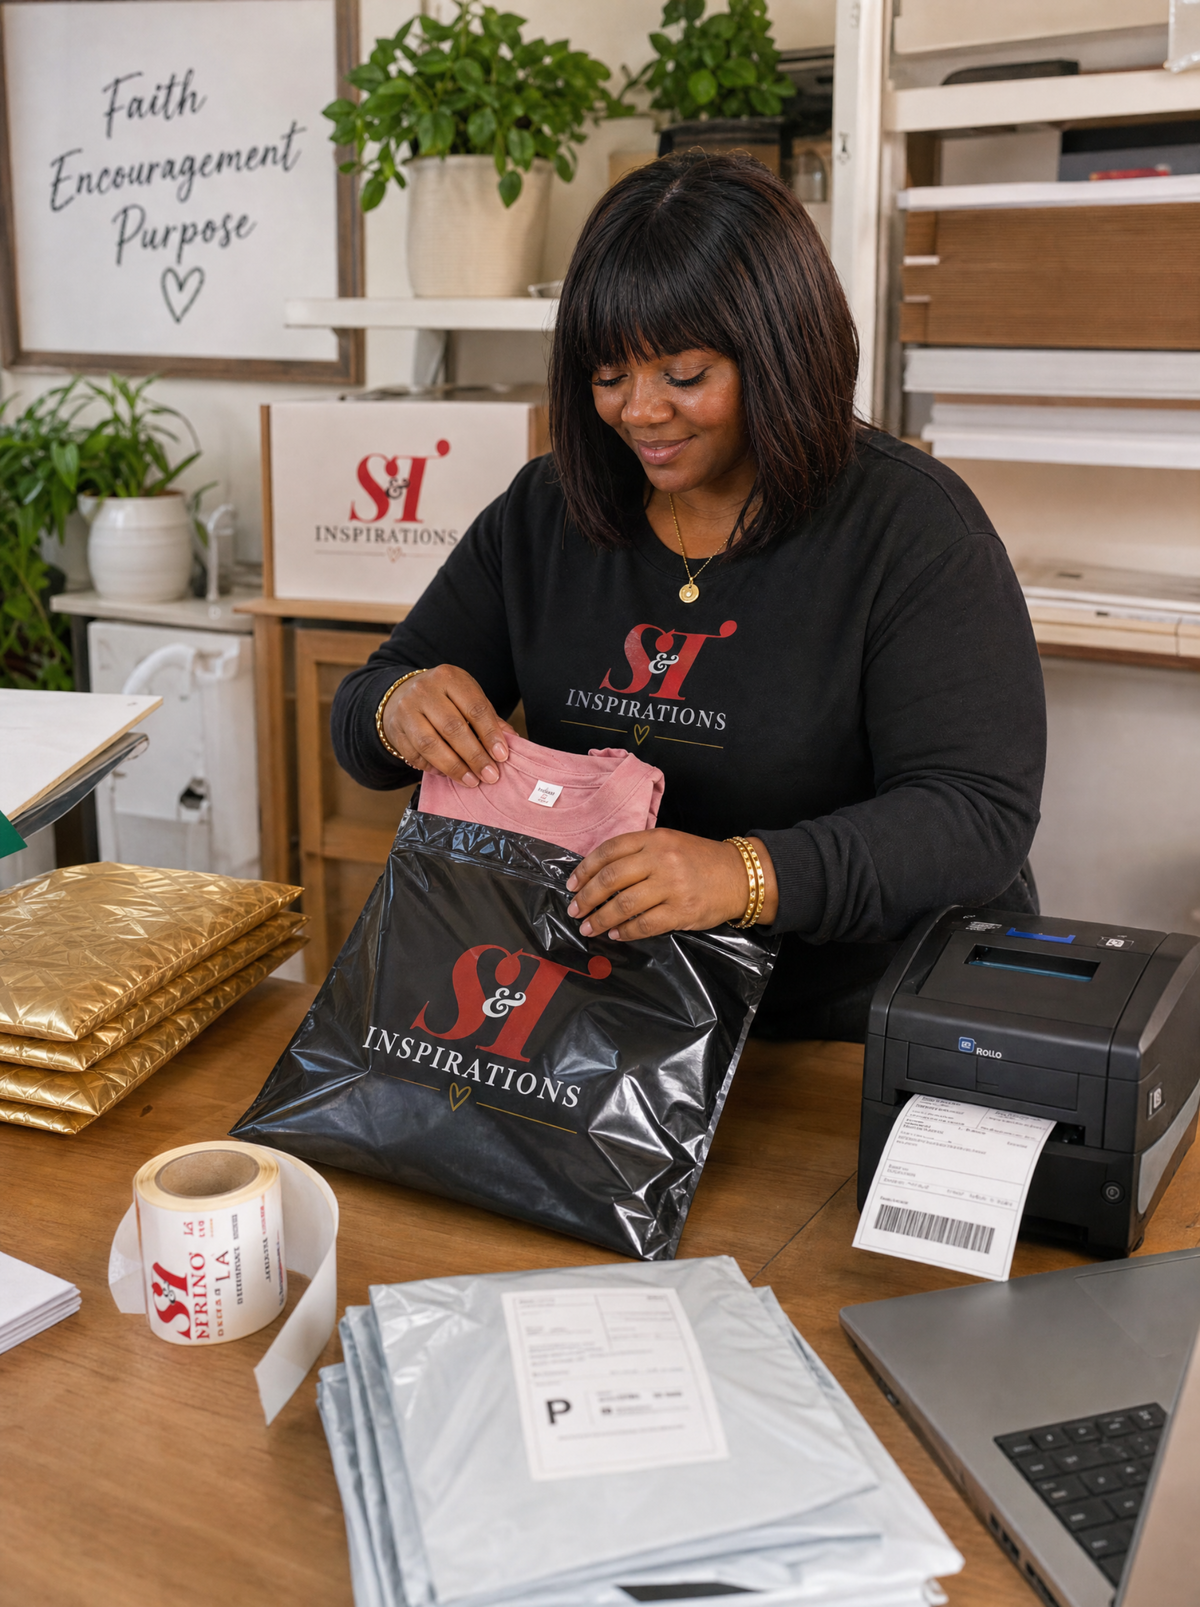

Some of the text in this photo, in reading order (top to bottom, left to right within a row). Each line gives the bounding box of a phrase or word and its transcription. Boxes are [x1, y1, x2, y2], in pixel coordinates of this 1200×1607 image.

[102, 68, 207, 138] Faith
[50, 121, 307, 212] Encouragement
[112, 204, 256, 265] Purpose
[315, 525, 459, 546] INSPIRATIONS
[566, 688, 727, 731] INSPIRATIONS
[362, 1026, 582, 1108] INSPIRATIONS
[545, 1398, 573, 1426] P
